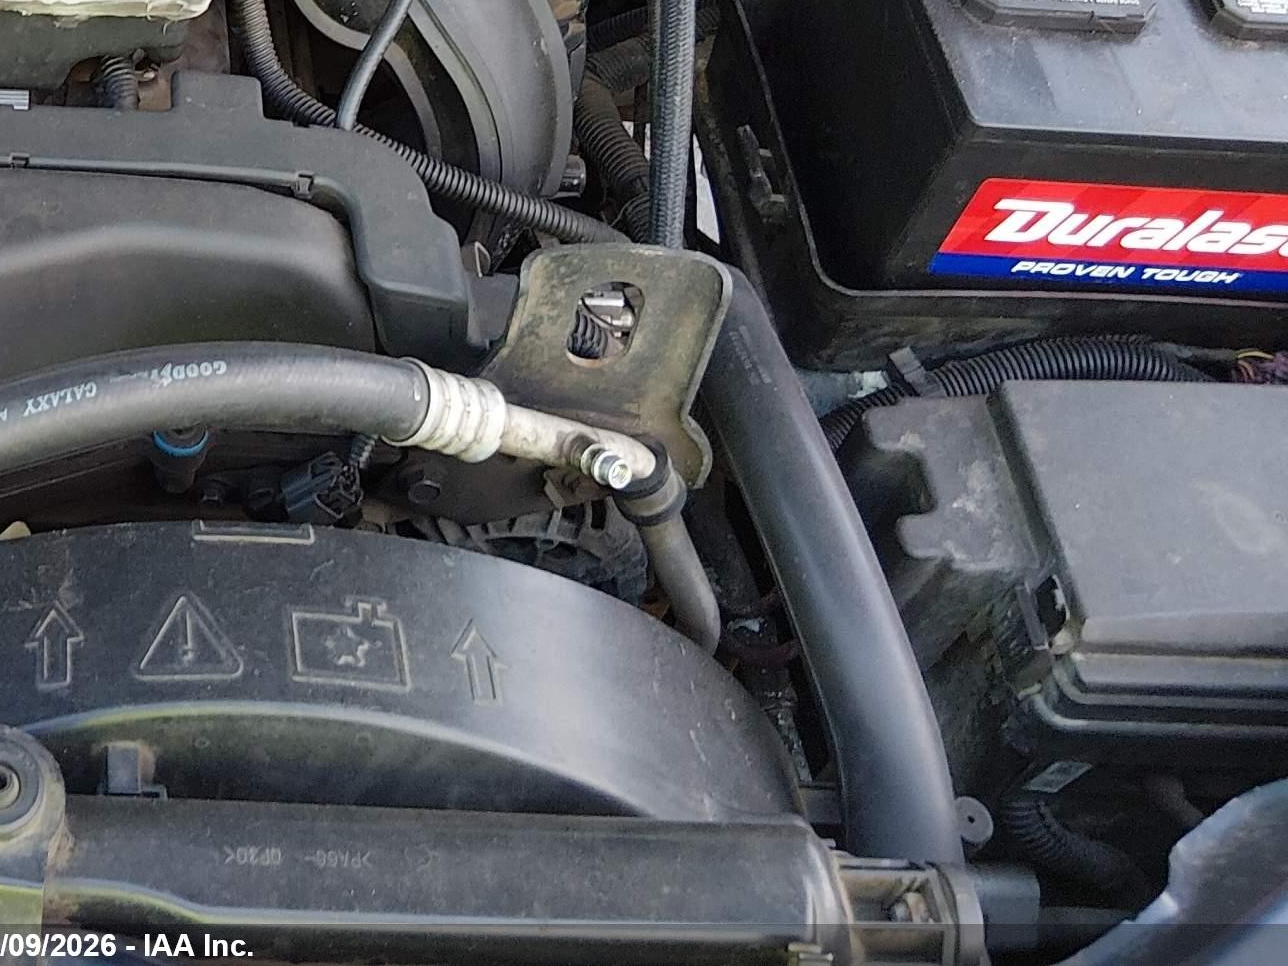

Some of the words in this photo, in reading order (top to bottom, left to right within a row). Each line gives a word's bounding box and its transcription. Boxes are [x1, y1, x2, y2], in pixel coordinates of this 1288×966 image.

[984, 198, 1288, 257] Duralas
[1011, 261, 1135, 279] PROVEN
[1142, 268, 1240, 284] TOUGH
[23, 382, 98, 417] GALAXY
